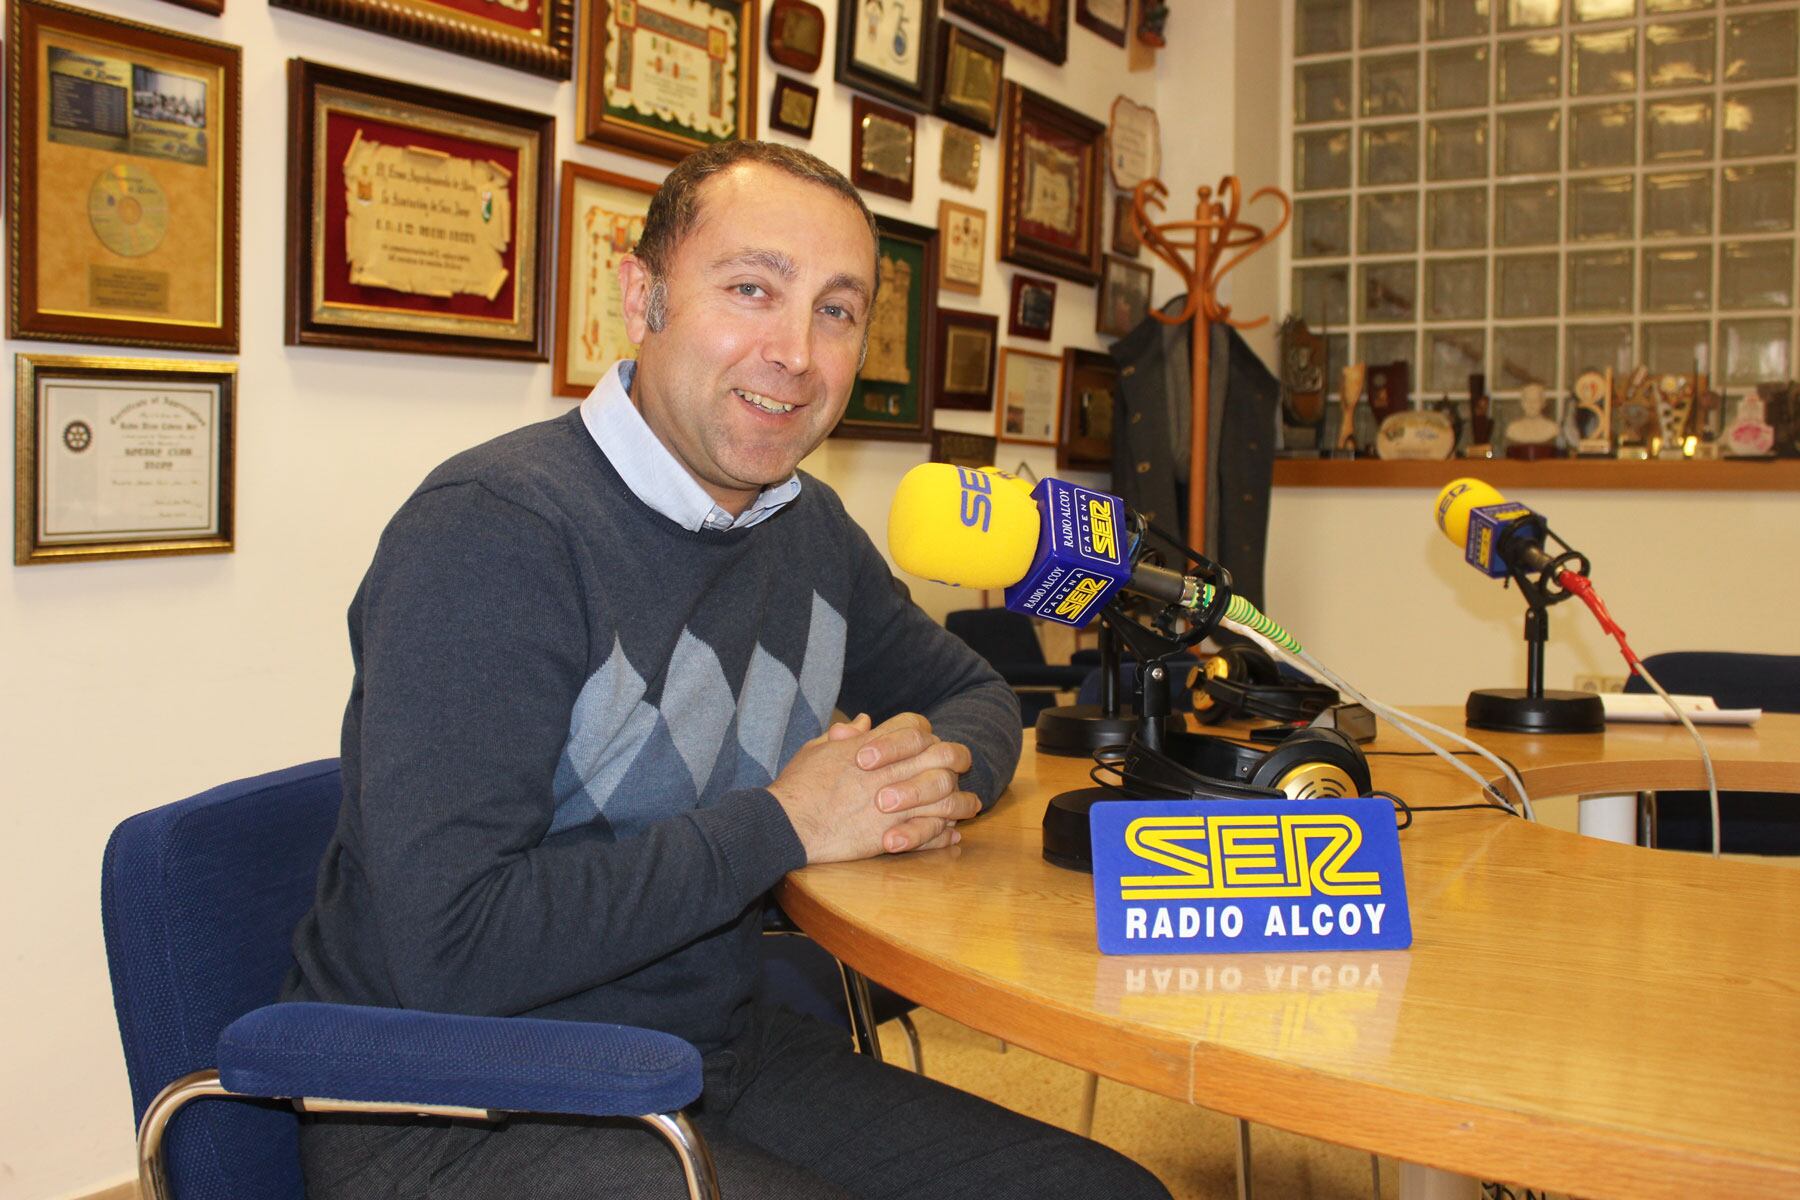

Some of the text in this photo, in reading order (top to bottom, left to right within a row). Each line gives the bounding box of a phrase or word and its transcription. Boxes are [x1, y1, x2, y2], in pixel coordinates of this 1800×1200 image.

[956, 465, 992, 533] SE
[1058, 488, 1074, 548] RADIO ALCOY
[1079, 494, 1092, 553] CADENA
[1089, 500, 1116, 559] SER
[1023, 566, 1065, 609] RADIO ALCOY
[1043, 572, 1084, 614] CADENA
[1055, 577, 1108, 620] SER
[1120, 815, 1382, 900] SER
[1125, 903, 1386, 939] RADIO ALCOY
